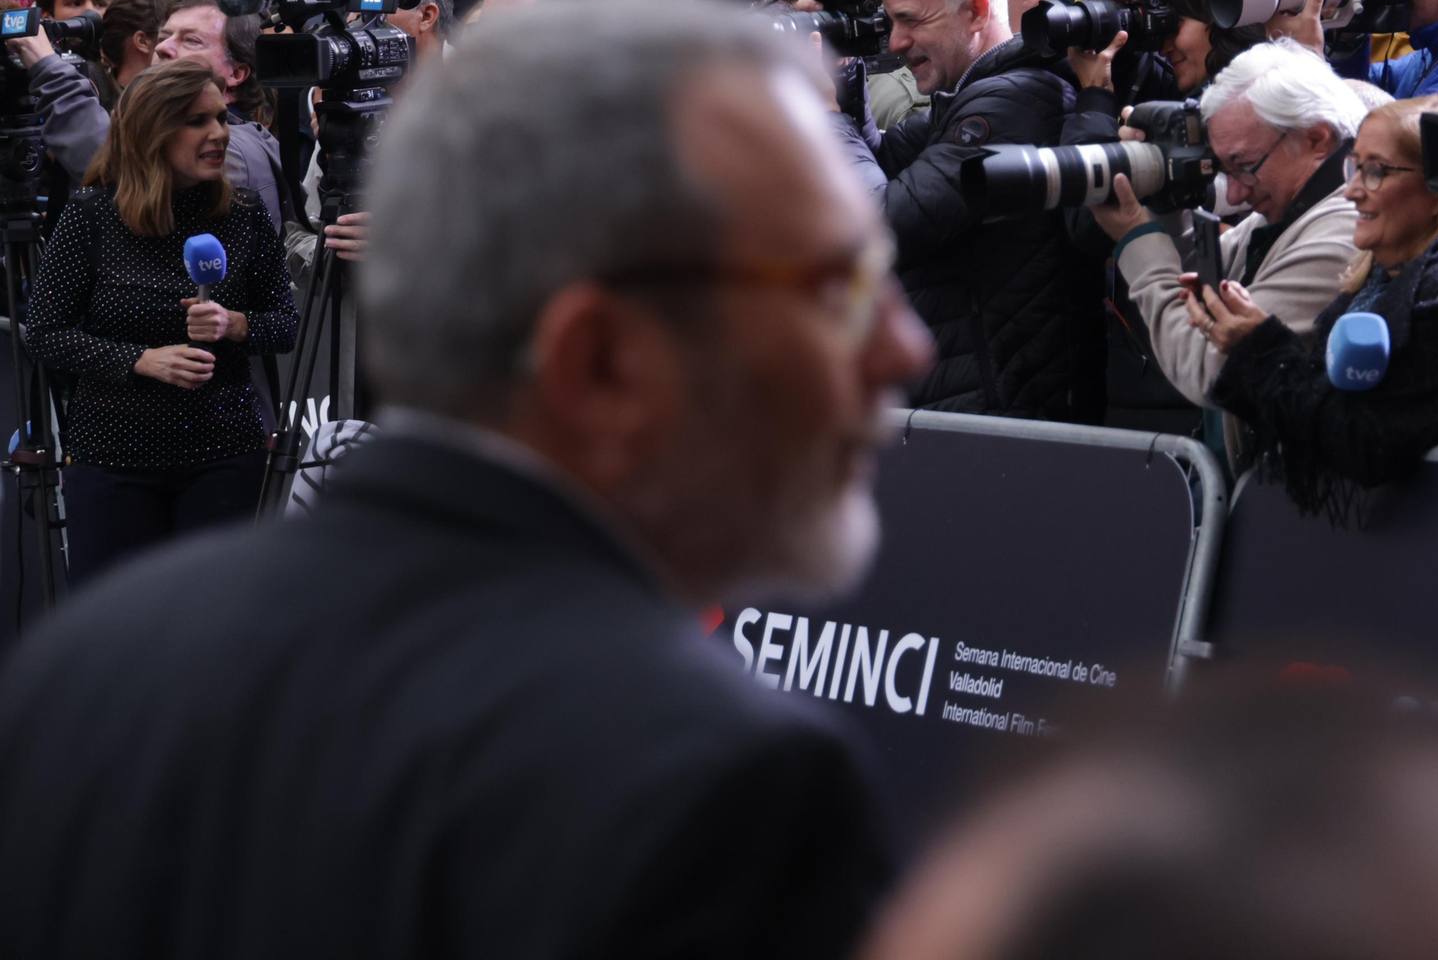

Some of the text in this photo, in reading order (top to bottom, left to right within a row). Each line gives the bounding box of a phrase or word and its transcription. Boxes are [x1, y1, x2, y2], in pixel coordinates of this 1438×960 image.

[4, 14, 25, 30] tve
[198, 257, 222, 272] tve
[1345, 365, 1380, 383] tve
[733, 607, 939, 715] SEMINCI
[954, 641, 1117, 687] Semana Internacional de Cine
[949, 670, 1003, 699] Valladolid
[942, 700, 1009, 731] International
[1009, 713, 1035, 736] Film
